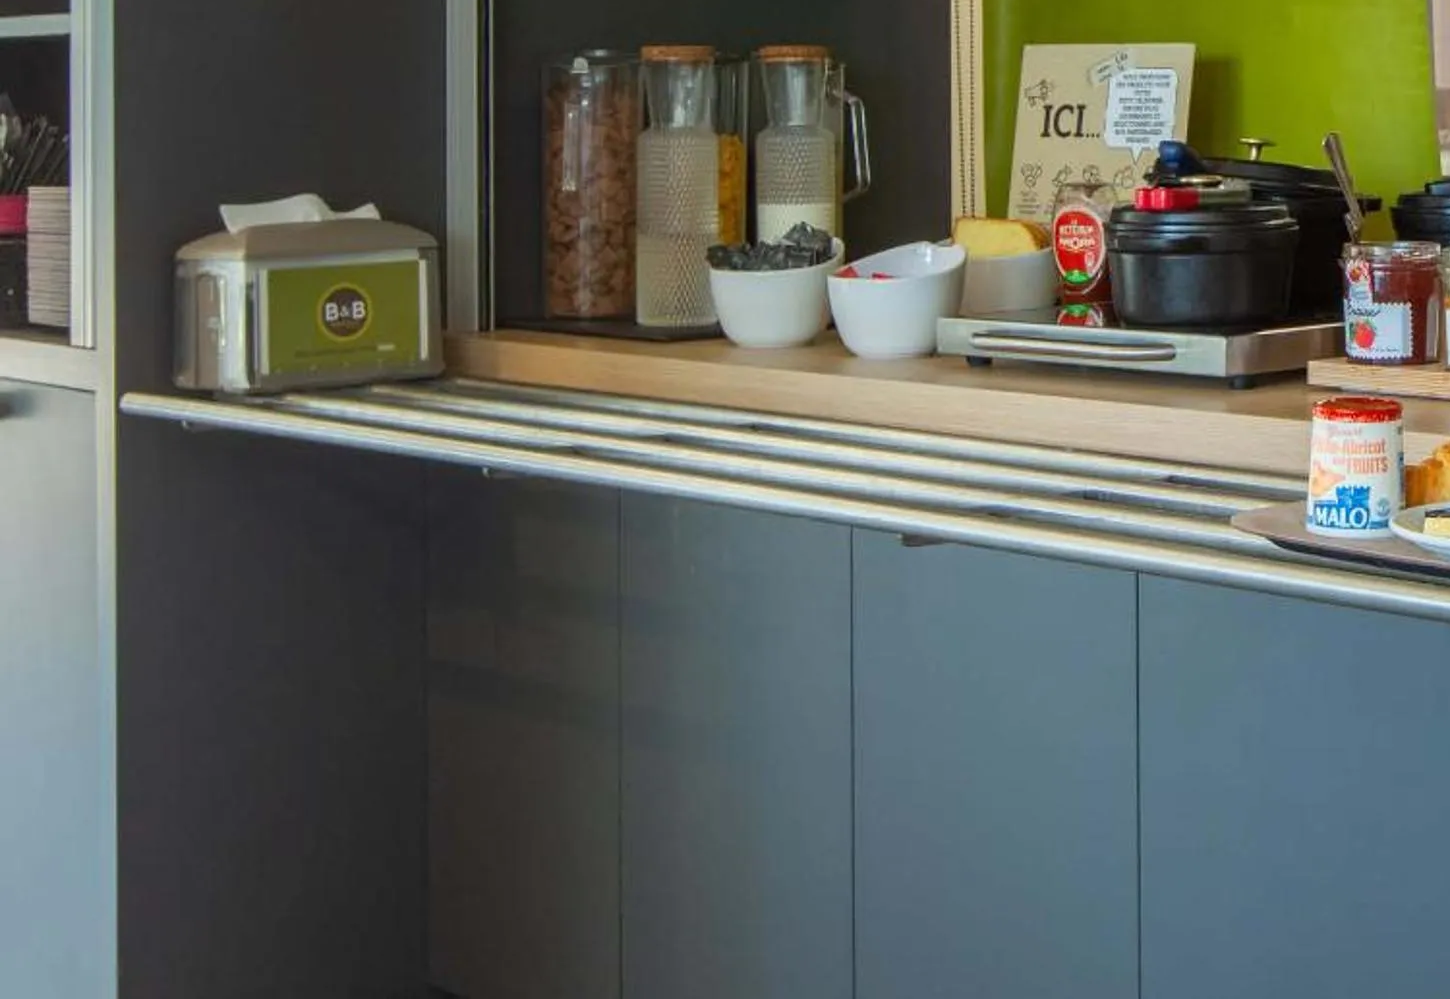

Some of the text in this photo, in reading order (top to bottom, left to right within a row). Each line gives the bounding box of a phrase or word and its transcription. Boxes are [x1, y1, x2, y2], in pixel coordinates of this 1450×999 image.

[1040, 104, 1101, 138] ICI...
[325, 300, 367, 321] B&B
[1315, 506, 1369, 528] MALO
